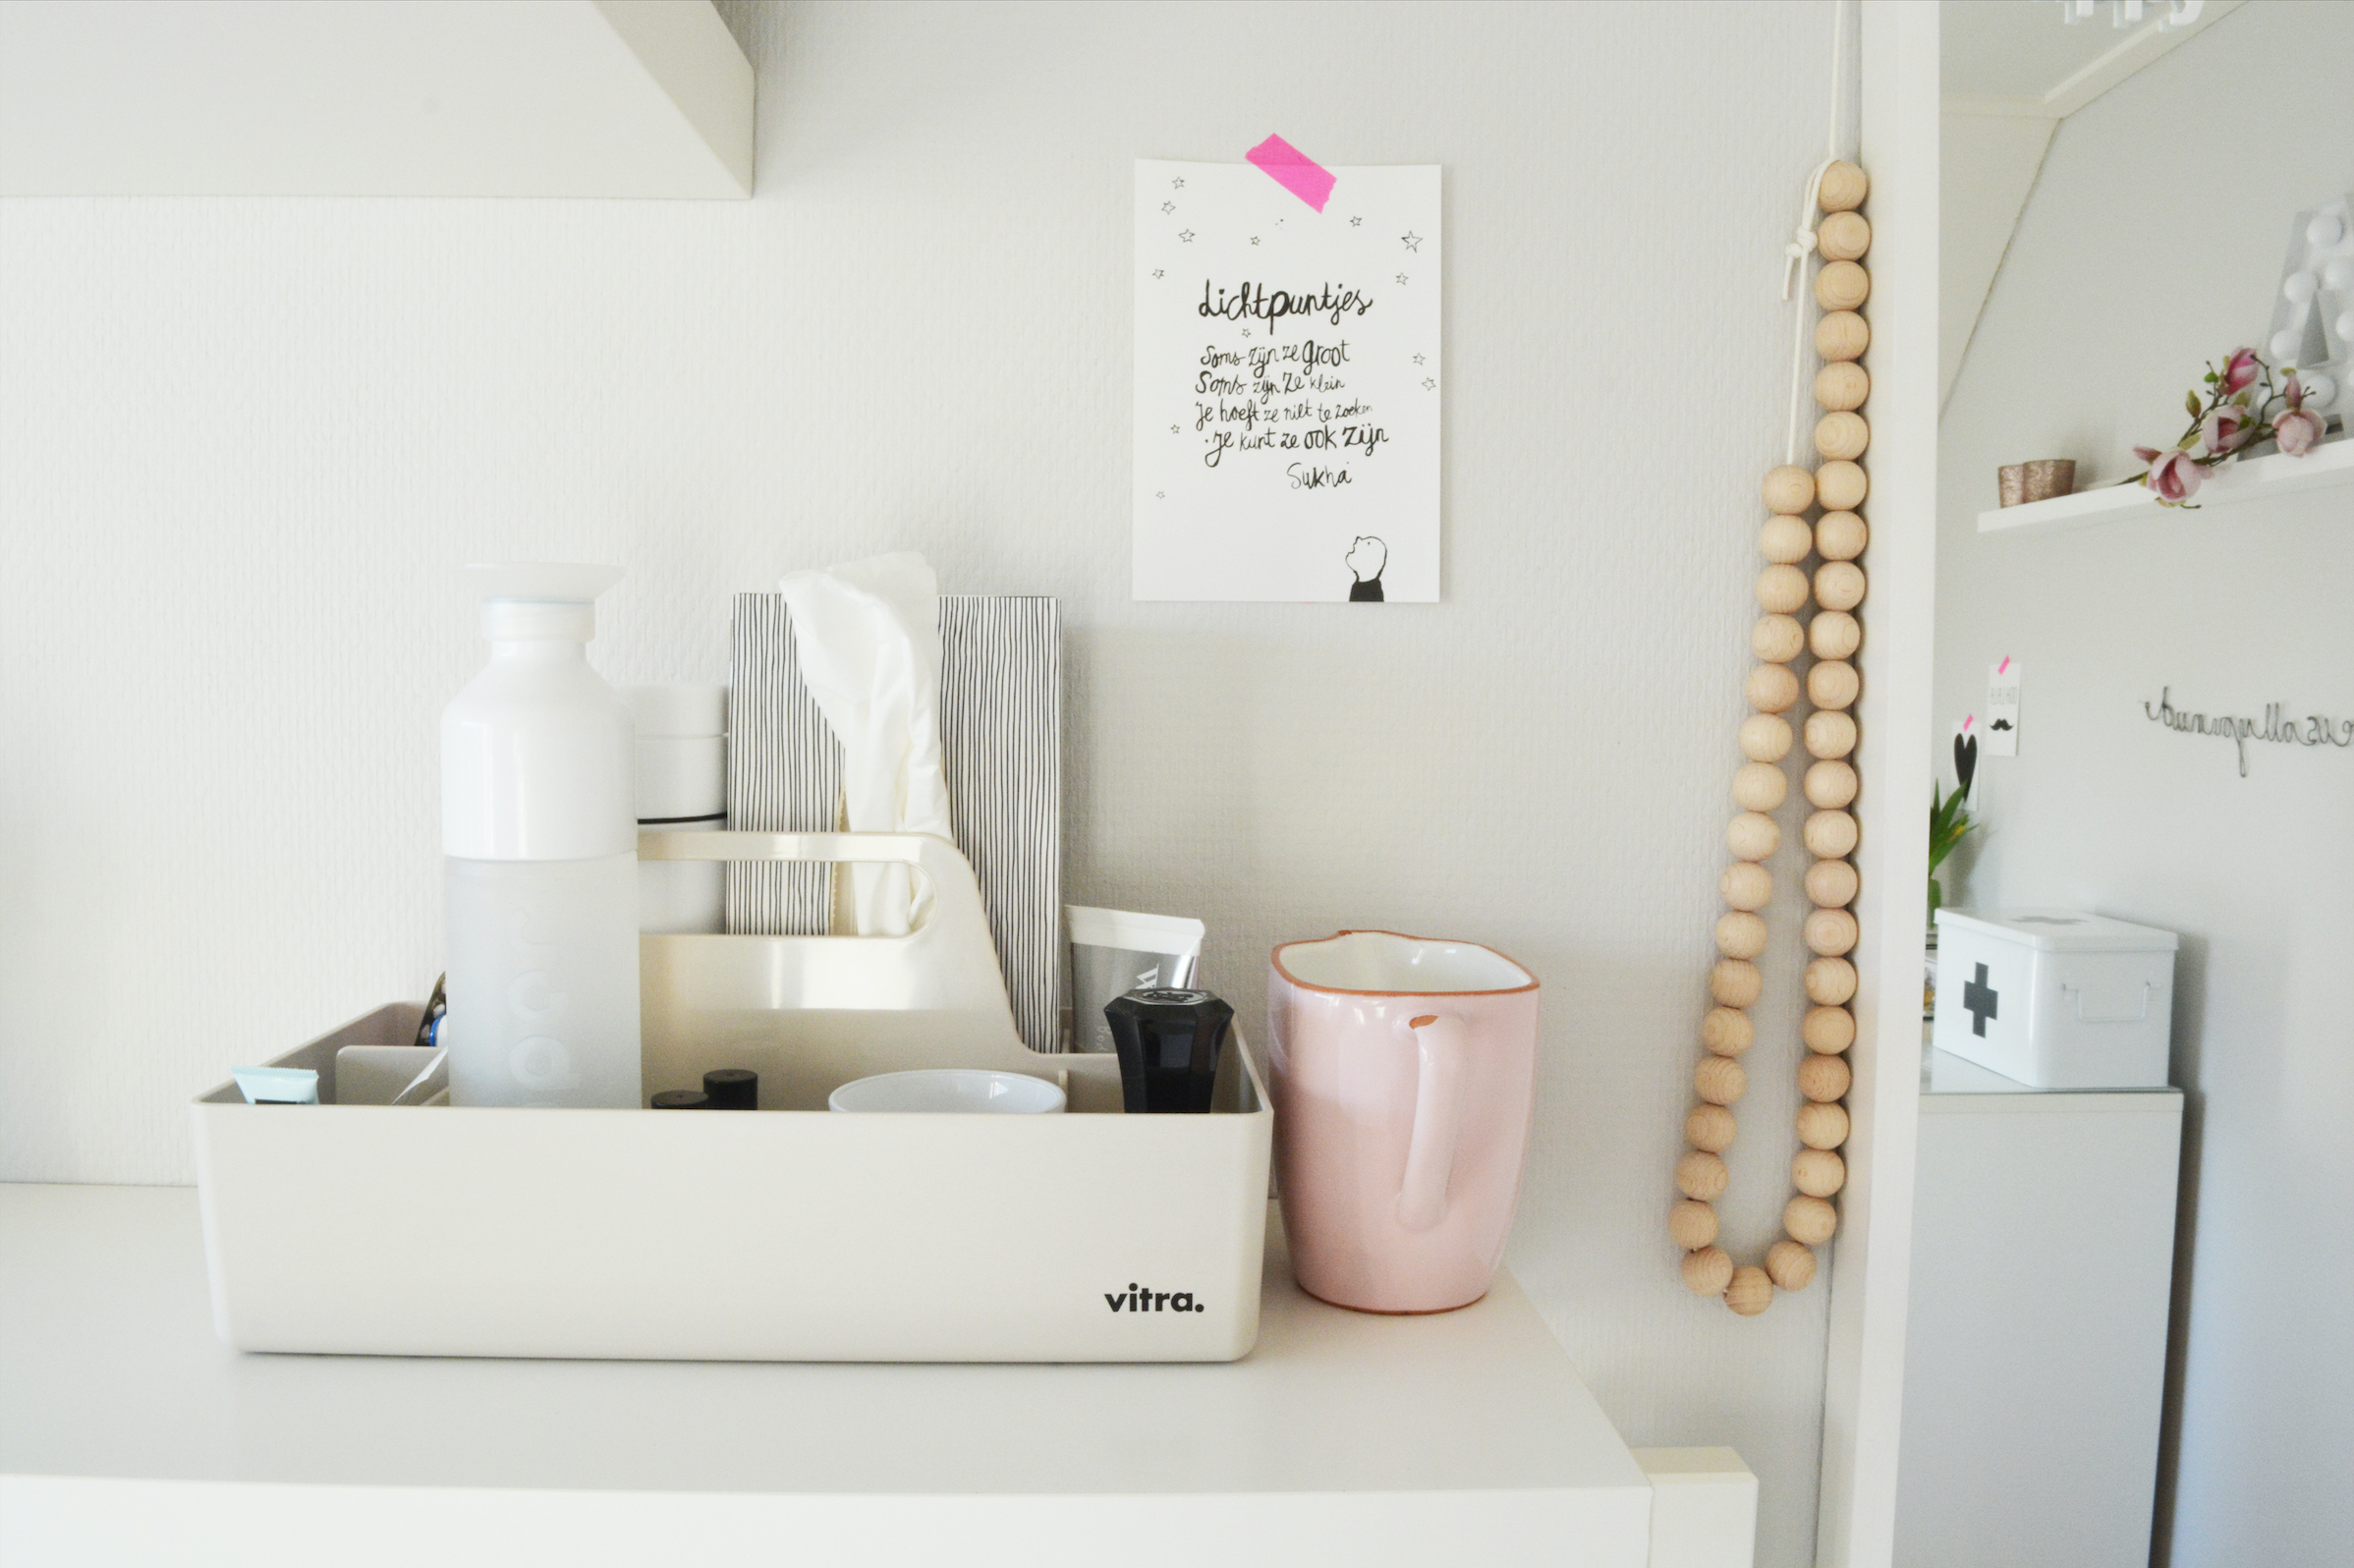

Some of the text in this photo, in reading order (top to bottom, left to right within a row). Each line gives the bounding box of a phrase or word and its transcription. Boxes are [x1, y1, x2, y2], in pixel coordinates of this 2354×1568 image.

[1198, 278, 1373, 336] Lichtpuntjes
[1302, 339, 1351, 376] groot
[1195, 369, 1248, 397] Soms
[1310, 373, 1346, 393] klein
[1219, 398, 1261, 432] hoeft
[1317, 403, 1332, 423] te
[1334, 397, 1373, 420] zoeken
[1239, 426, 1277, 453] kunt
[1303, 423, 1338, 451] ook
[1103, 1282, 1205, 1314] vitra.
